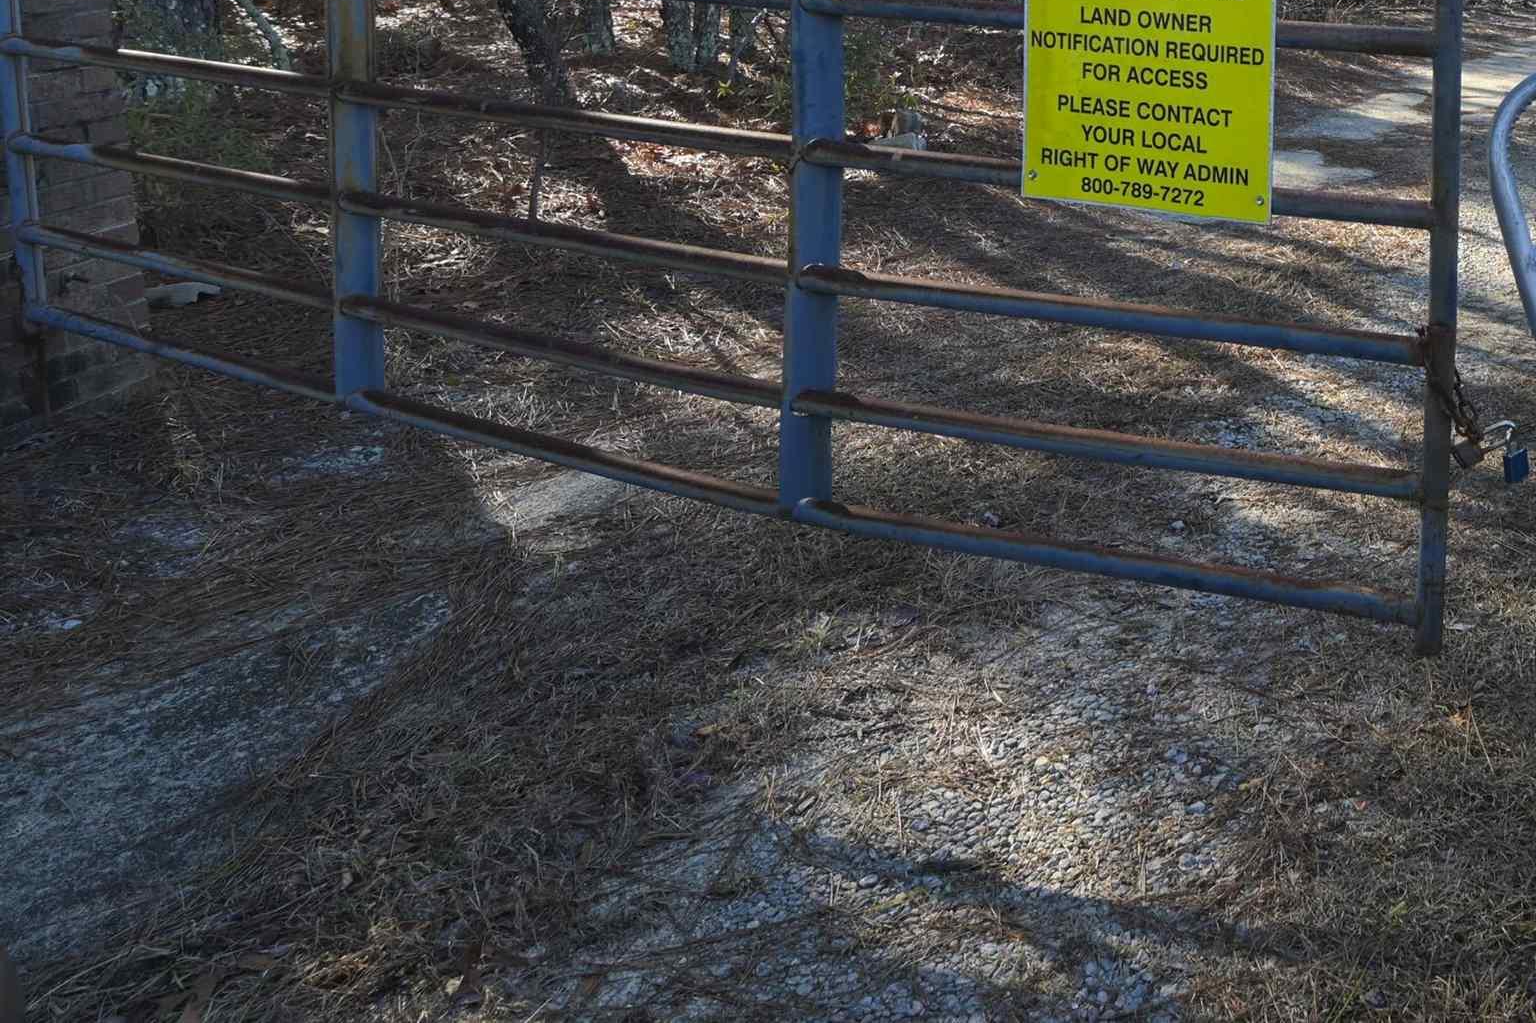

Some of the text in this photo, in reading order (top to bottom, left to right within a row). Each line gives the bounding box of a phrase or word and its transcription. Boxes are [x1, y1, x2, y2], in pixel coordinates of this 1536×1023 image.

[1081, 6, 1211, 33] LAND OWNER
[1032, 30, 1264, 65] NOTIFICATION REQUIRED
[1083, 63, 1207, 89] FOR ACCESS
[1058, 95, 1232, 127] PLEASE CONTACT
[1082, 125, 1207, 153] YOUR LOCAL
[1041, 148, 1248, 186] RIGHT OF WAY ADMIN
[1082, 177, 1204, 206] 800-789-7272
